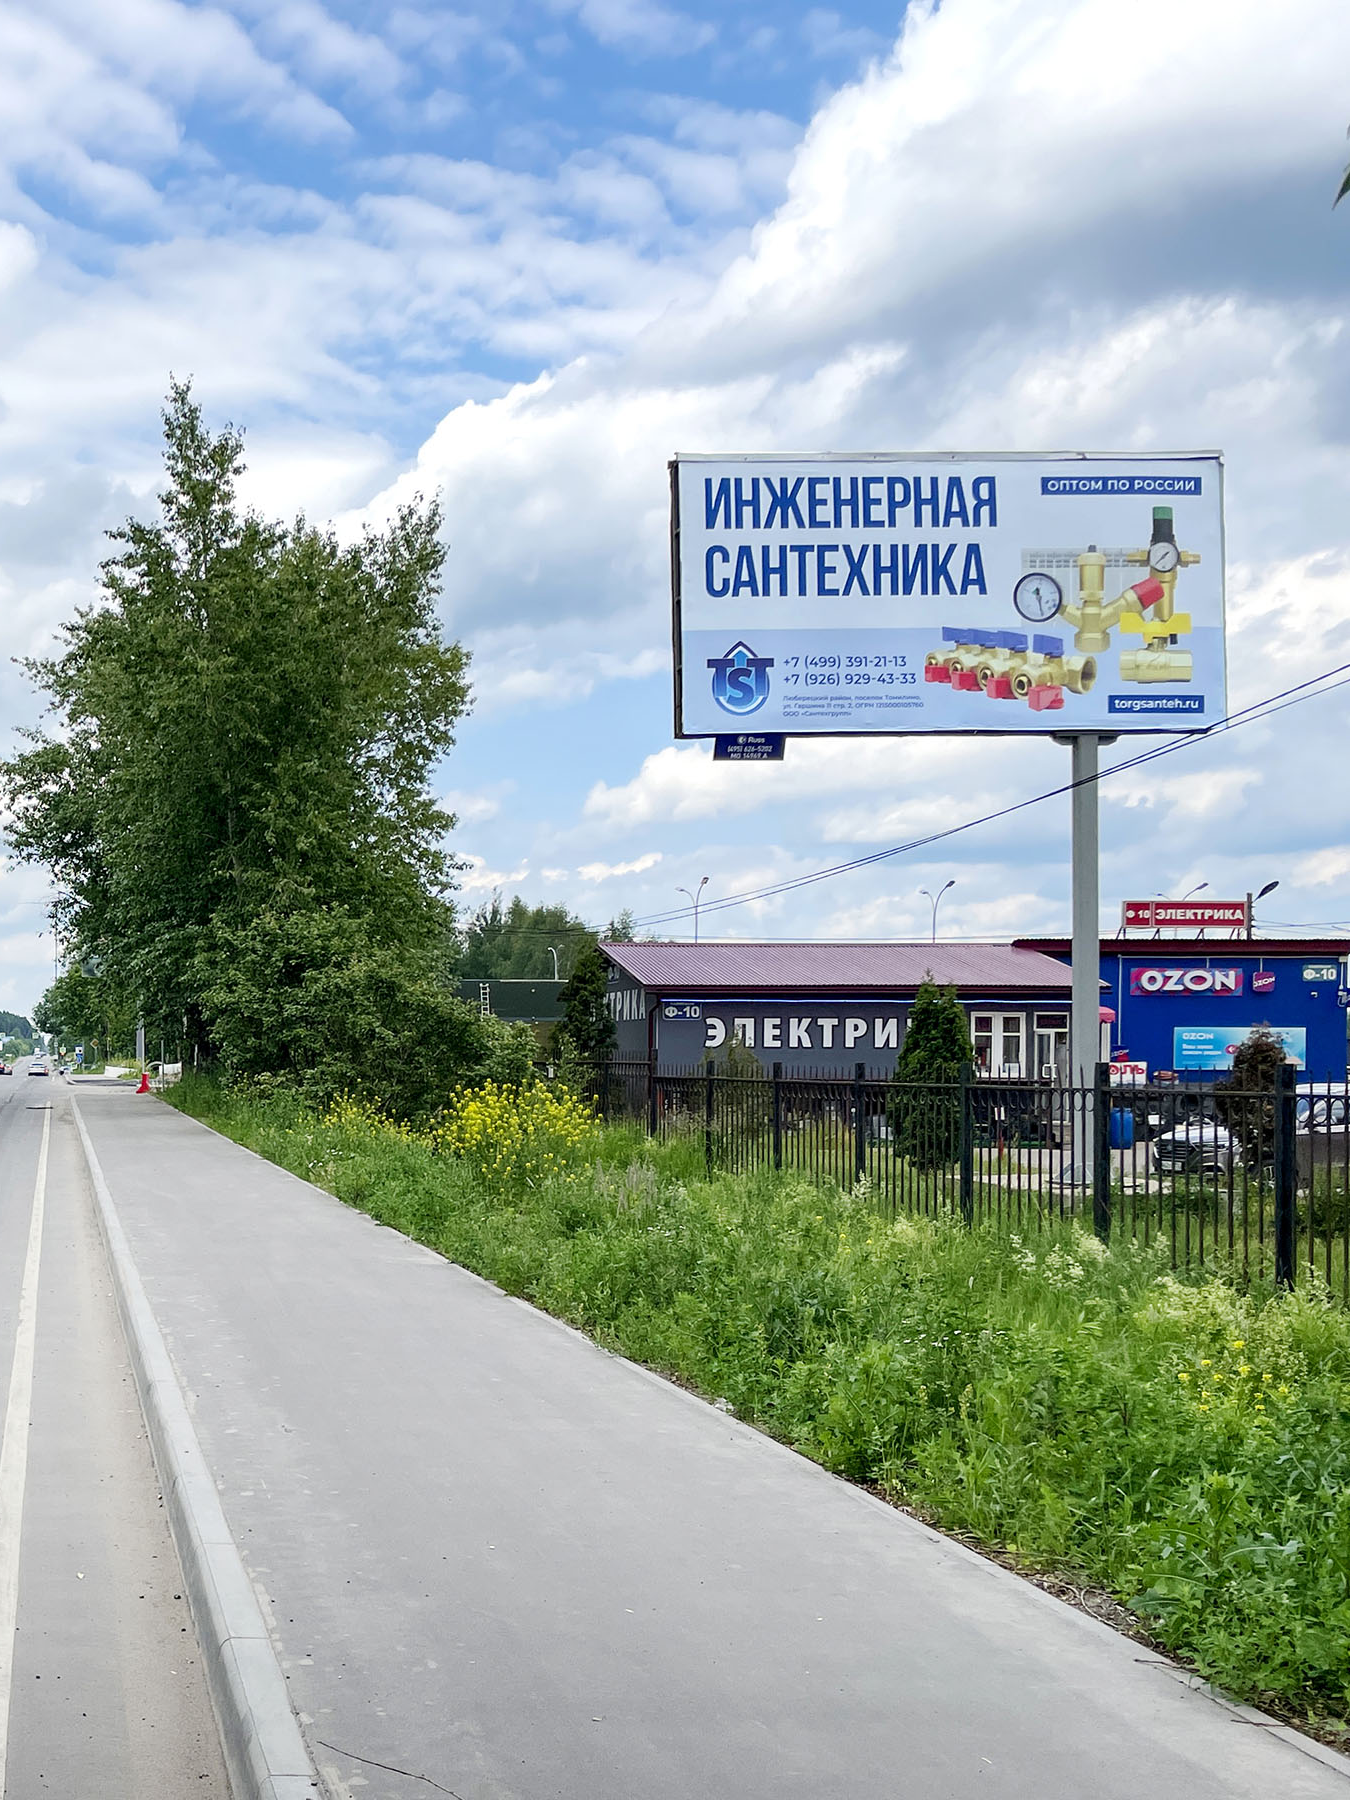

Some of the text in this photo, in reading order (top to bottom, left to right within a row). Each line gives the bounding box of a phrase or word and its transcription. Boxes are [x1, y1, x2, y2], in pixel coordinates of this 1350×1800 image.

[1047, 480, 1195, 491] ОПТОМ ПО РОССИИ
[704, 476, 997, 529] ИНЖЕНЕРНАЯ
[705, 543, 988, 598] САНТЕХНИКА
[783, 655, 907, 669] +7 (499) 391-21-13
[783, 672, 917, 686] +7 (926) 929-43-33
[1114, 698, 1199, 711] torgsanteh.ru
[1138, 910, 1150, 919] 10
[1155, 909, 1244, 920] ЭЛЕКТРИКА
[1140, 970, 1236, 991] OZON
[1303, 968, 1337, 980] Ф-10
[665, 1005, 700, 1018] Ф-10
[704, 1017, 912, 1049] ЭЛЕКТРИ
[1182, 1032, 1214, 1040] OZON
